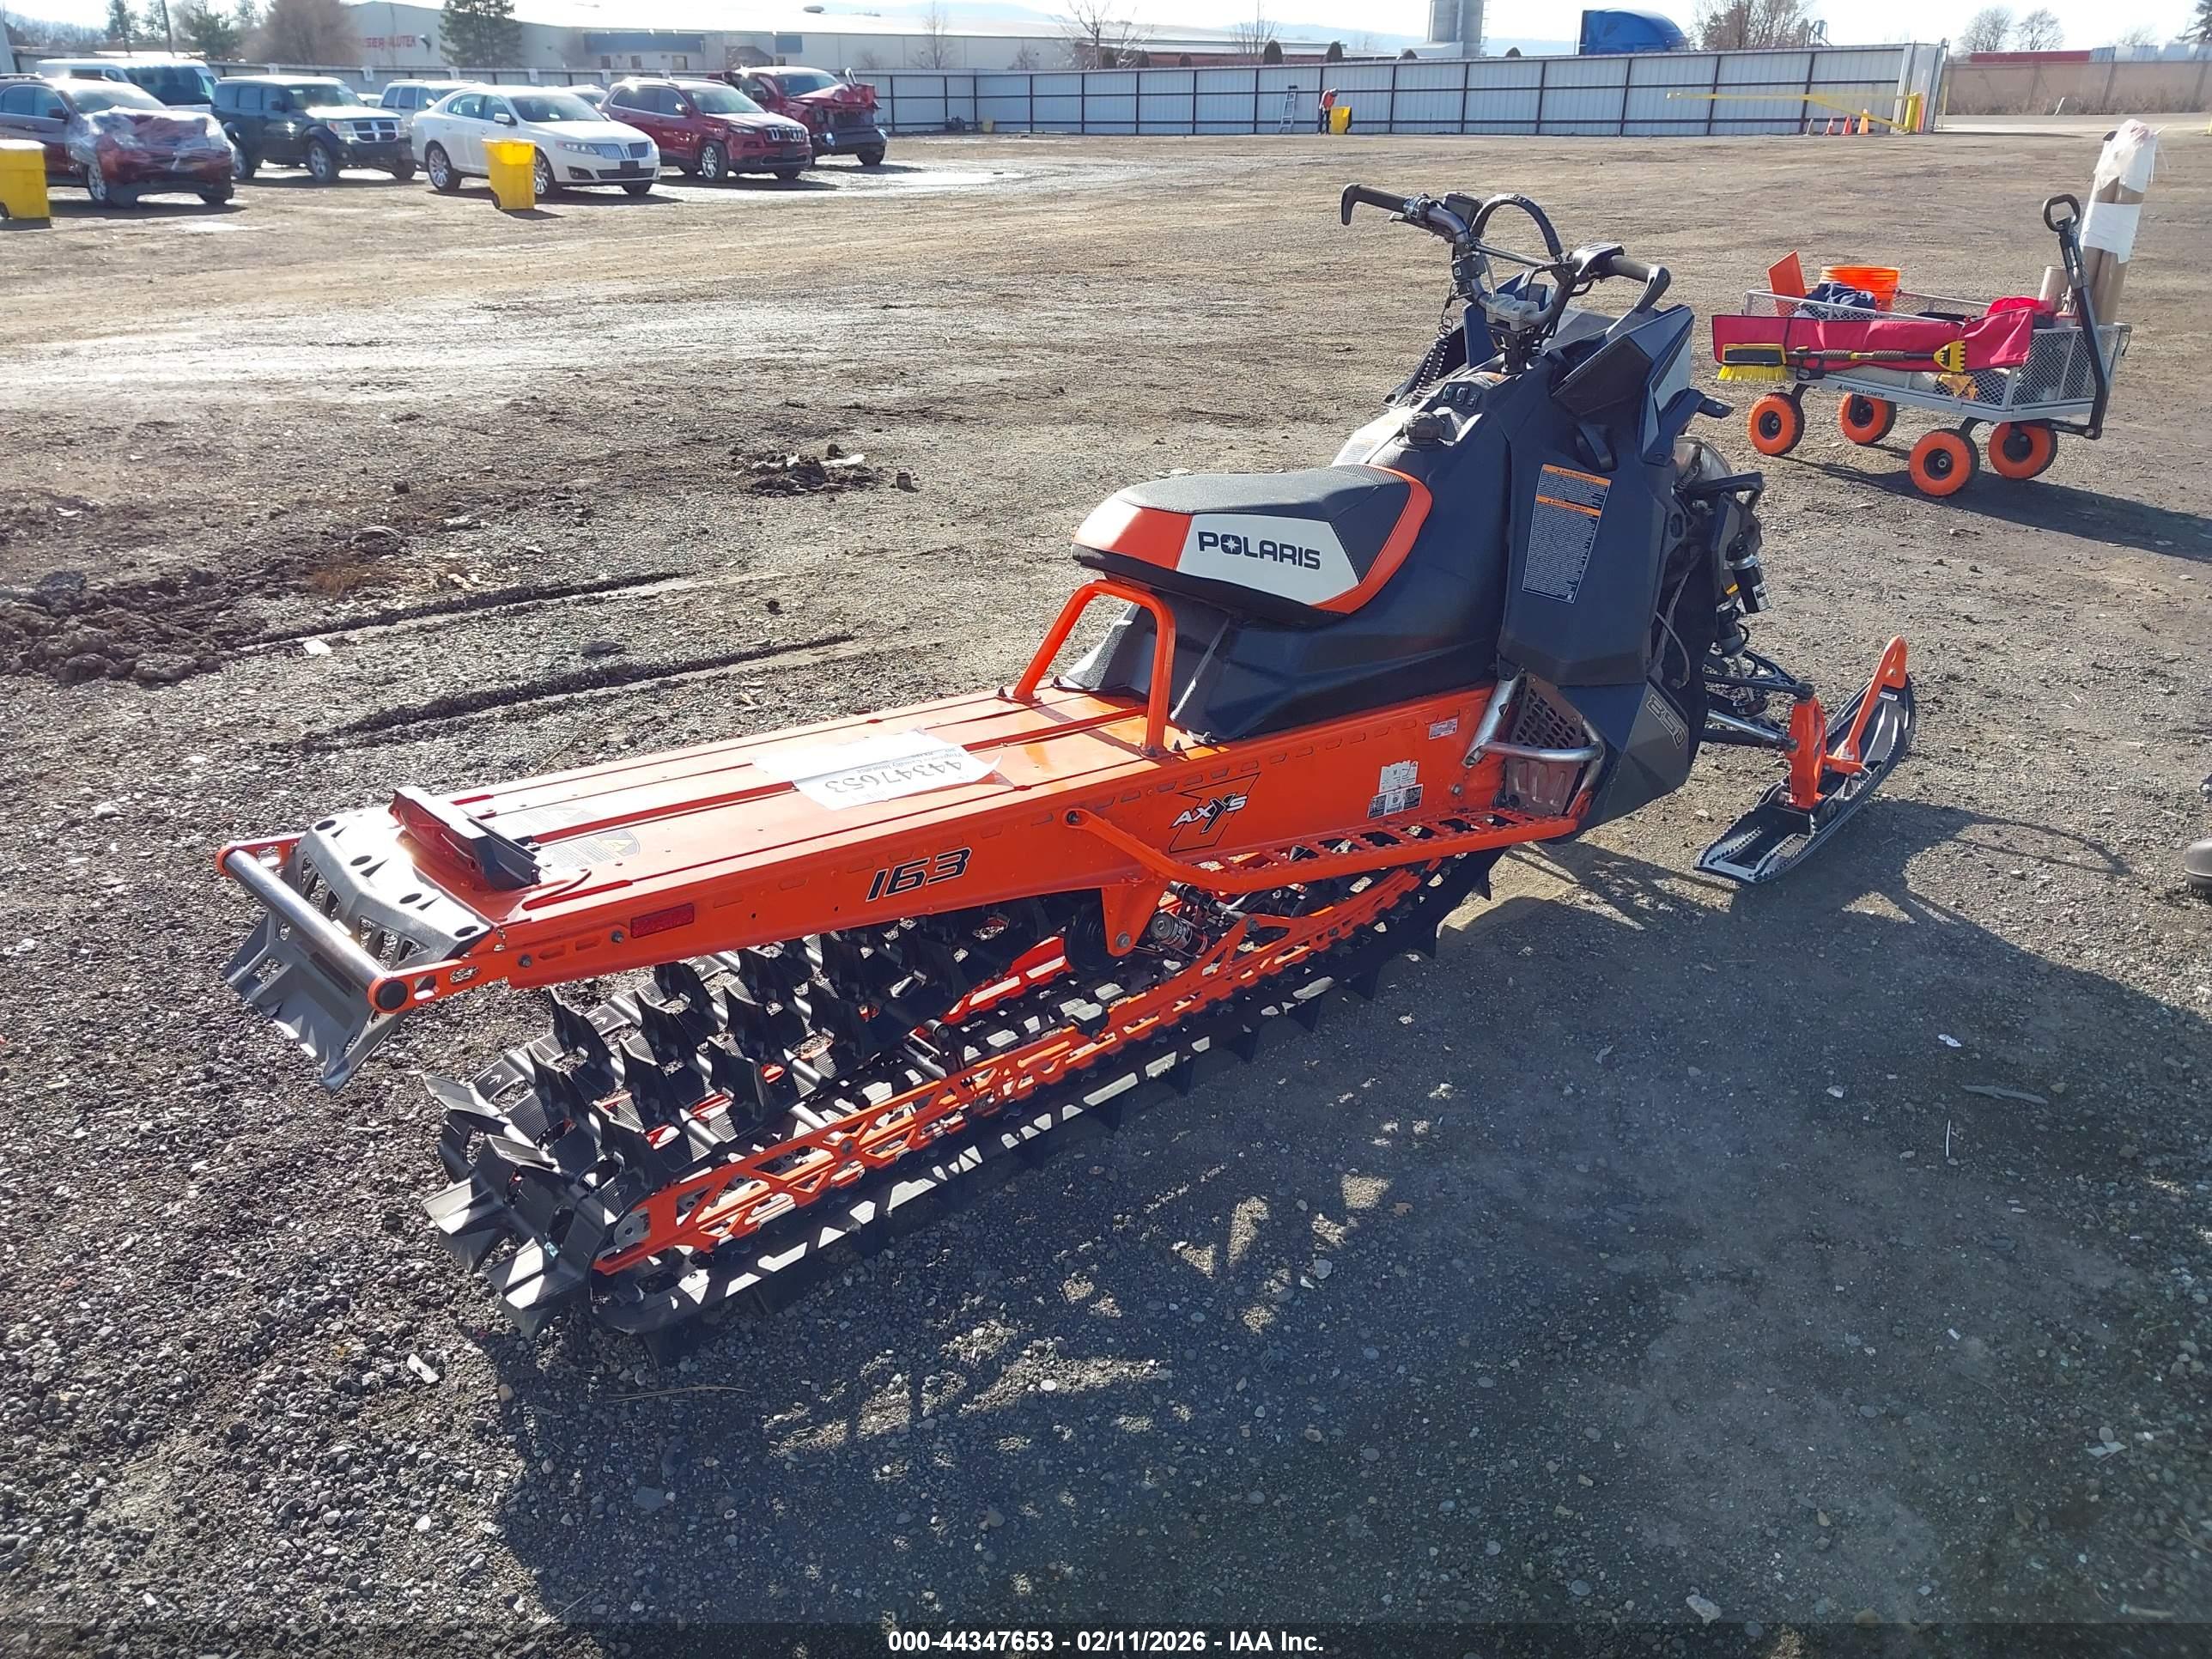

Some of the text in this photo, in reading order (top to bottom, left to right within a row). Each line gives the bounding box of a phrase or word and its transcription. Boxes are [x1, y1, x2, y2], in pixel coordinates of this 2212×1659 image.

[1197, 531, 1322, 570] POLARIS
[1645, 694, 1686, 749] 850
[824, 760, 962, 793] 44347653
[1169, 792, 1249, 835] AXYS
[866, 847, 973, 902] 163
